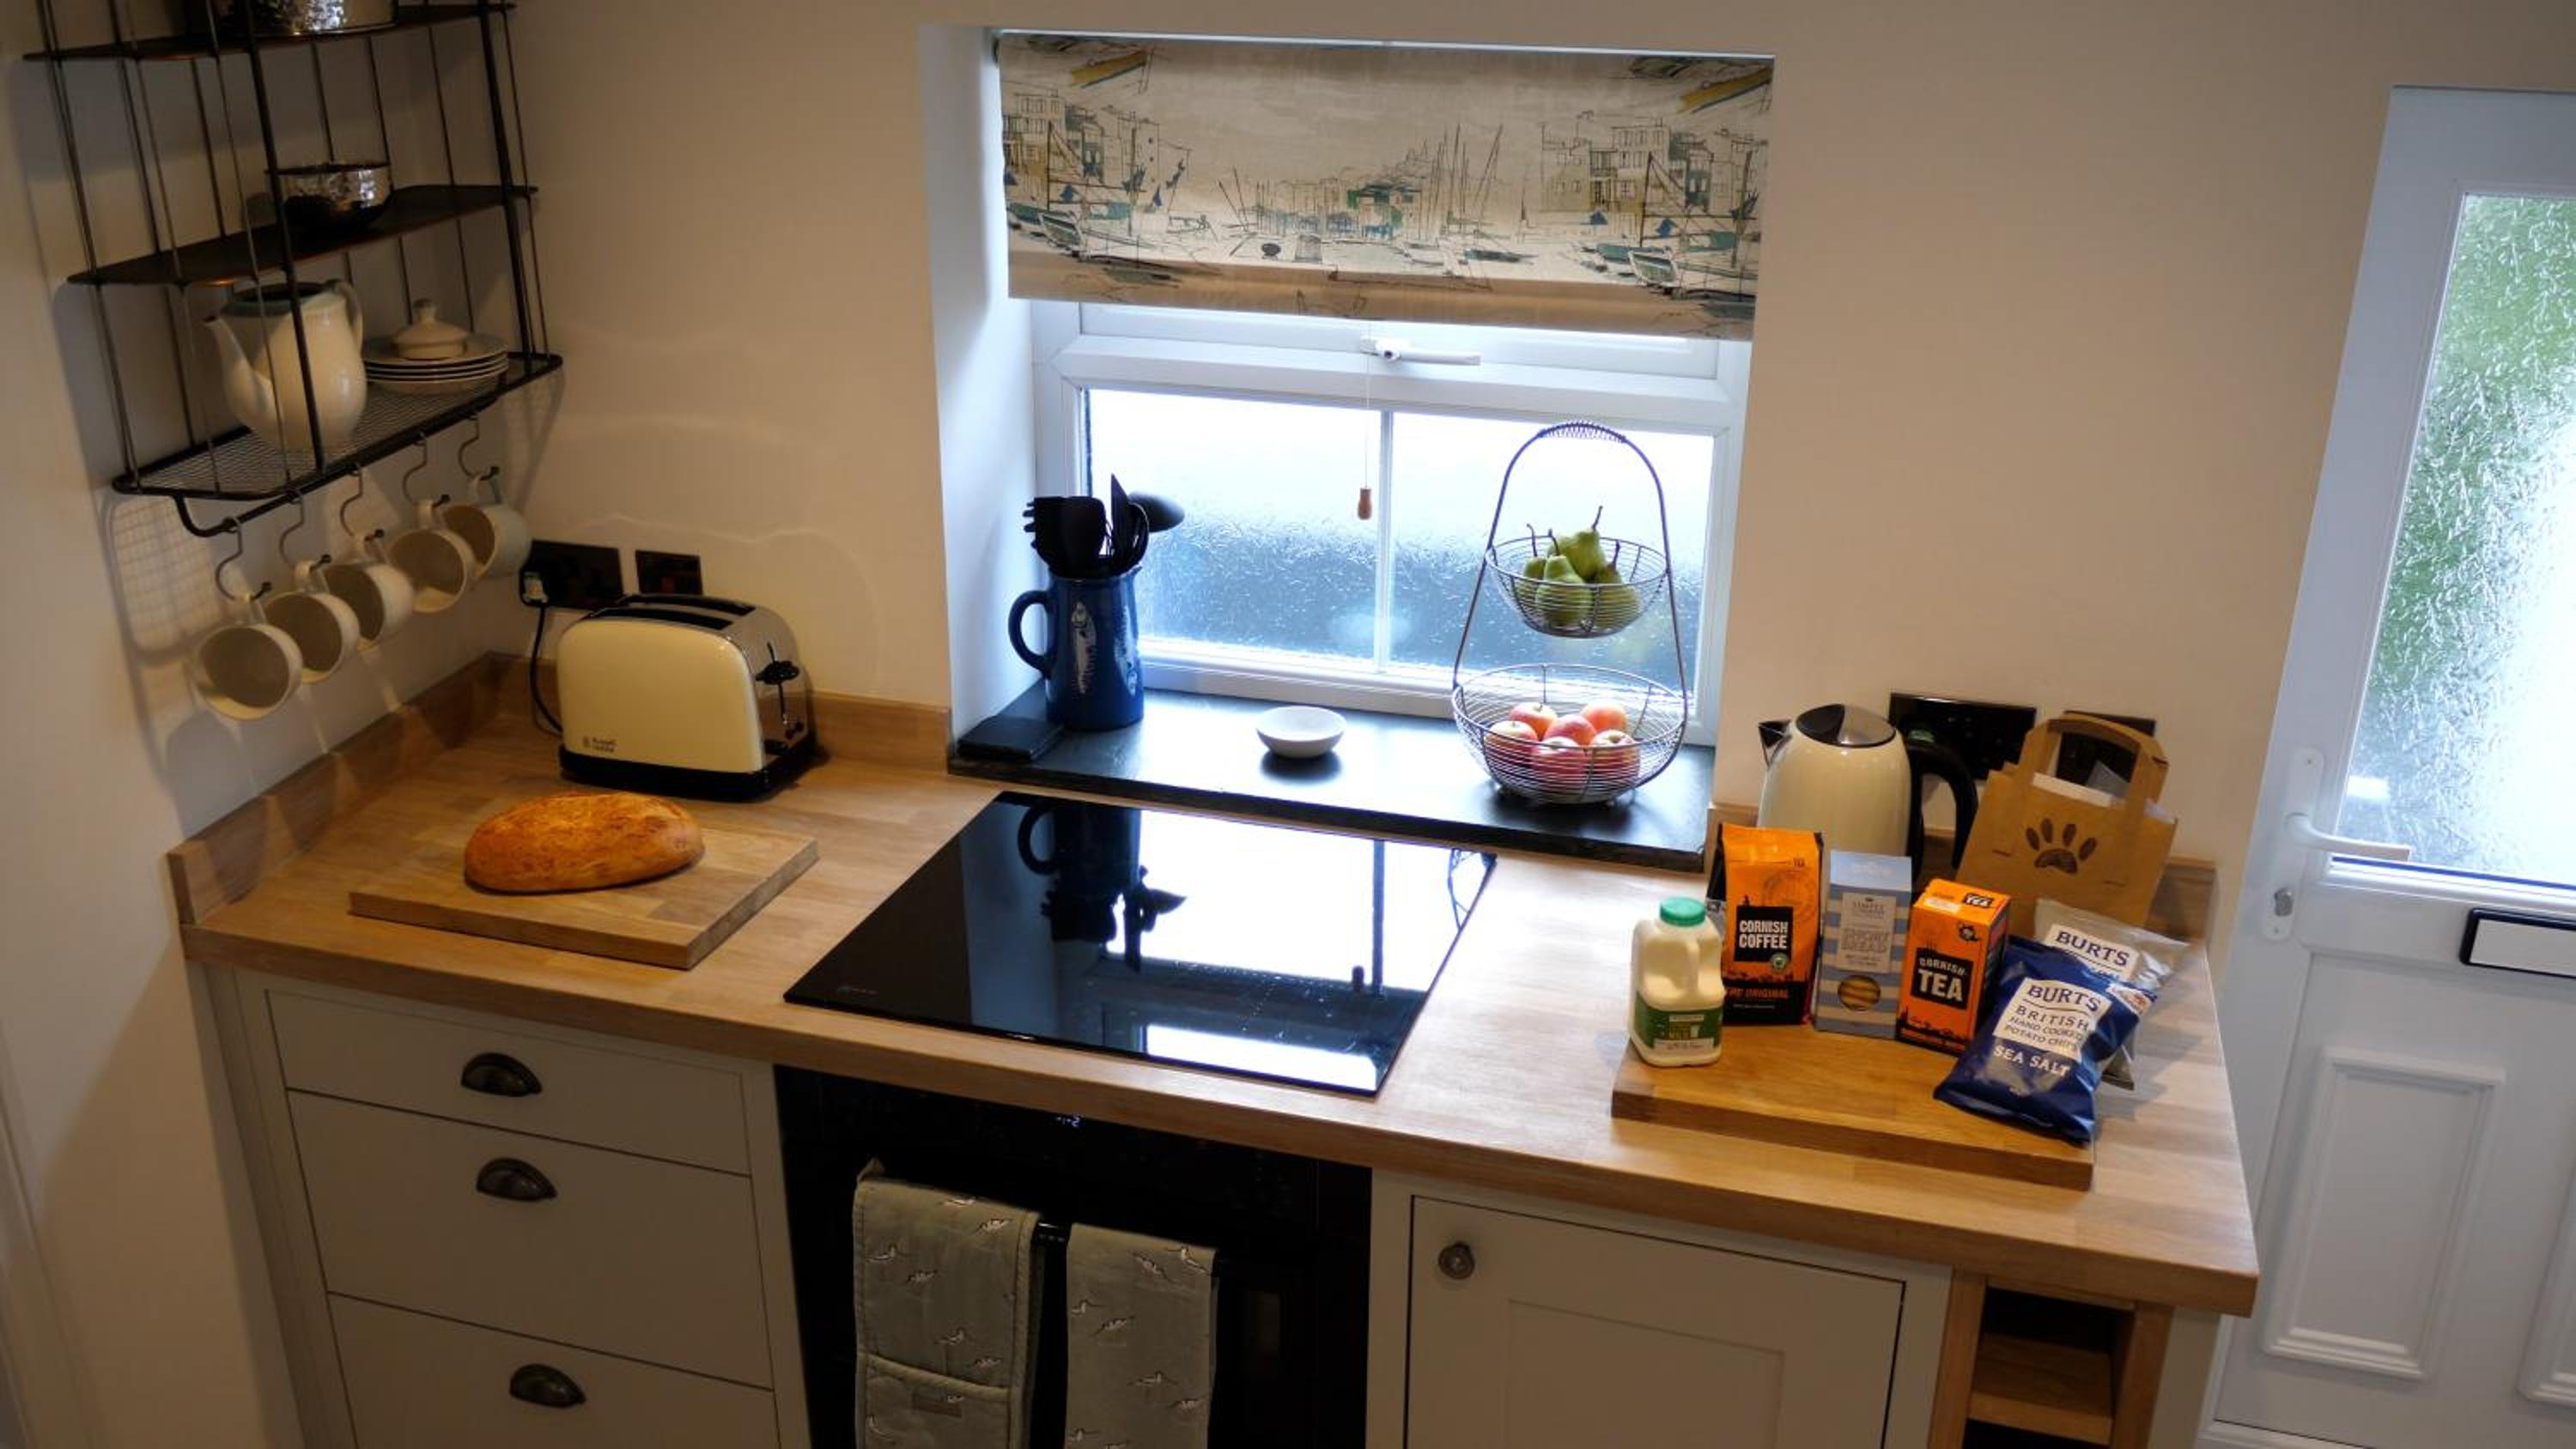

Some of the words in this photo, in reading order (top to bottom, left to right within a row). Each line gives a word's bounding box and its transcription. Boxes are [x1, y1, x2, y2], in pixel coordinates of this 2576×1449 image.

[1739, 919, 1789, 933] CORNISH
[1738, 933, 1788, 949] COFFEE
[2056, 931, 2130, 967] BURTS
[1918, 957, 1966, 976] CORNISH
[1917, 968, 1964, 1003] TEA
[2027, 985, 2102, 1012] BURTS
[2009, 1016, 2041, 1030] HAND
[2015, 1004, 2089, 1032] BRITISH
[2005, 1024, 2046, 1043] POTATO
[1993, 1045, 2024, 1064] SEA
[2030, 1055, 2071, 1076] SALT
